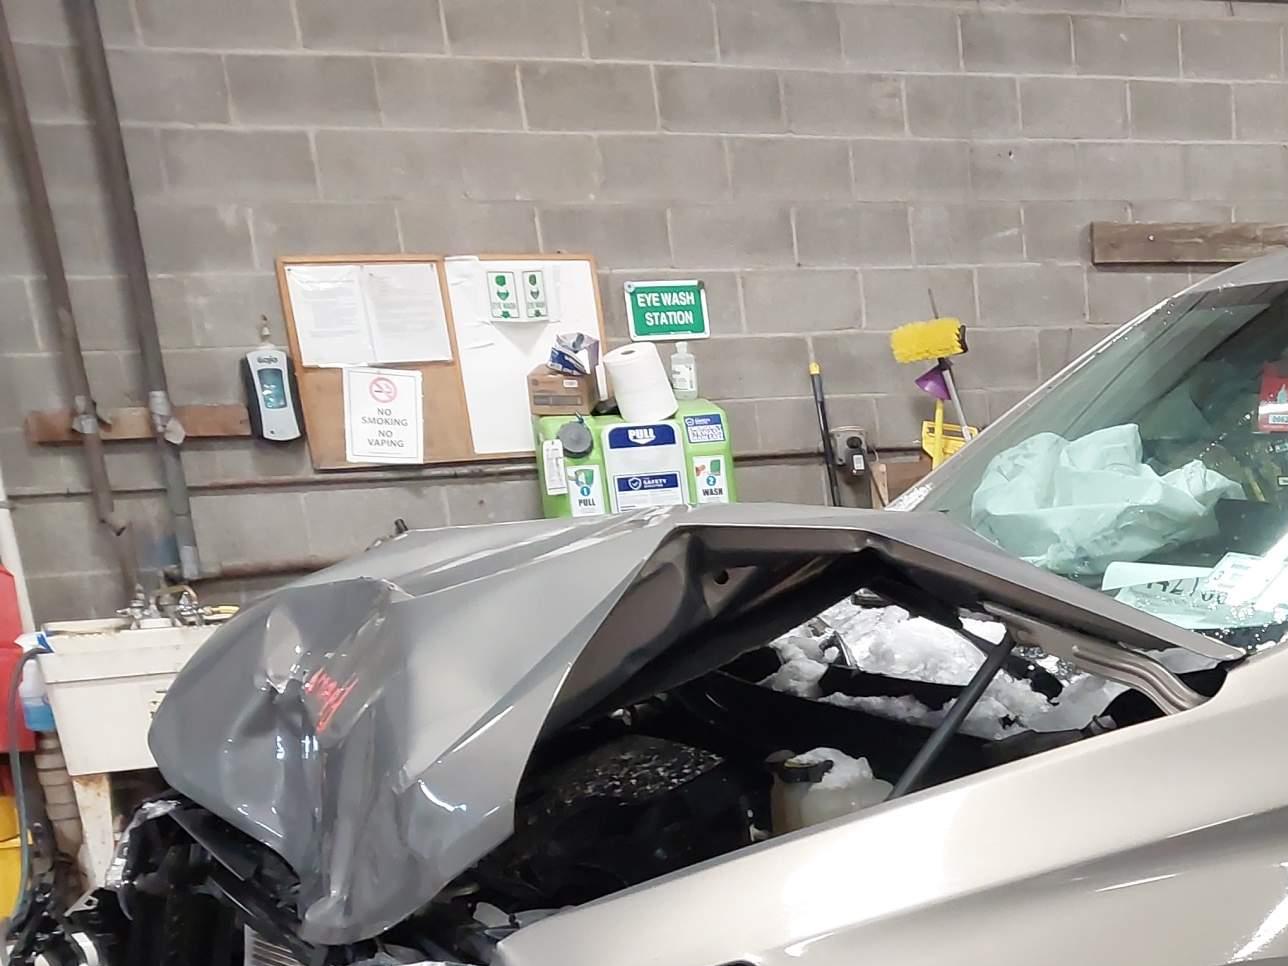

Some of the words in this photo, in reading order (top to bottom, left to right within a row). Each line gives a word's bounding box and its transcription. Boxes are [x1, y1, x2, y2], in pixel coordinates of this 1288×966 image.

[637, 293, 660, 307] EYE
[661, 292, 695, 306] WASH
[645, 311, 694, 326] STATION
[377, 408, 392, 416] NO
[361, 416, 408, 427] SMOKING
[378, 430, 393, 438] NO
[628, 428, 655, 440] PULL
[367, 439, 404, 448] VAPING
[702, 488, 723, 496] WASH
[578, 498, 596, 507] PULL
